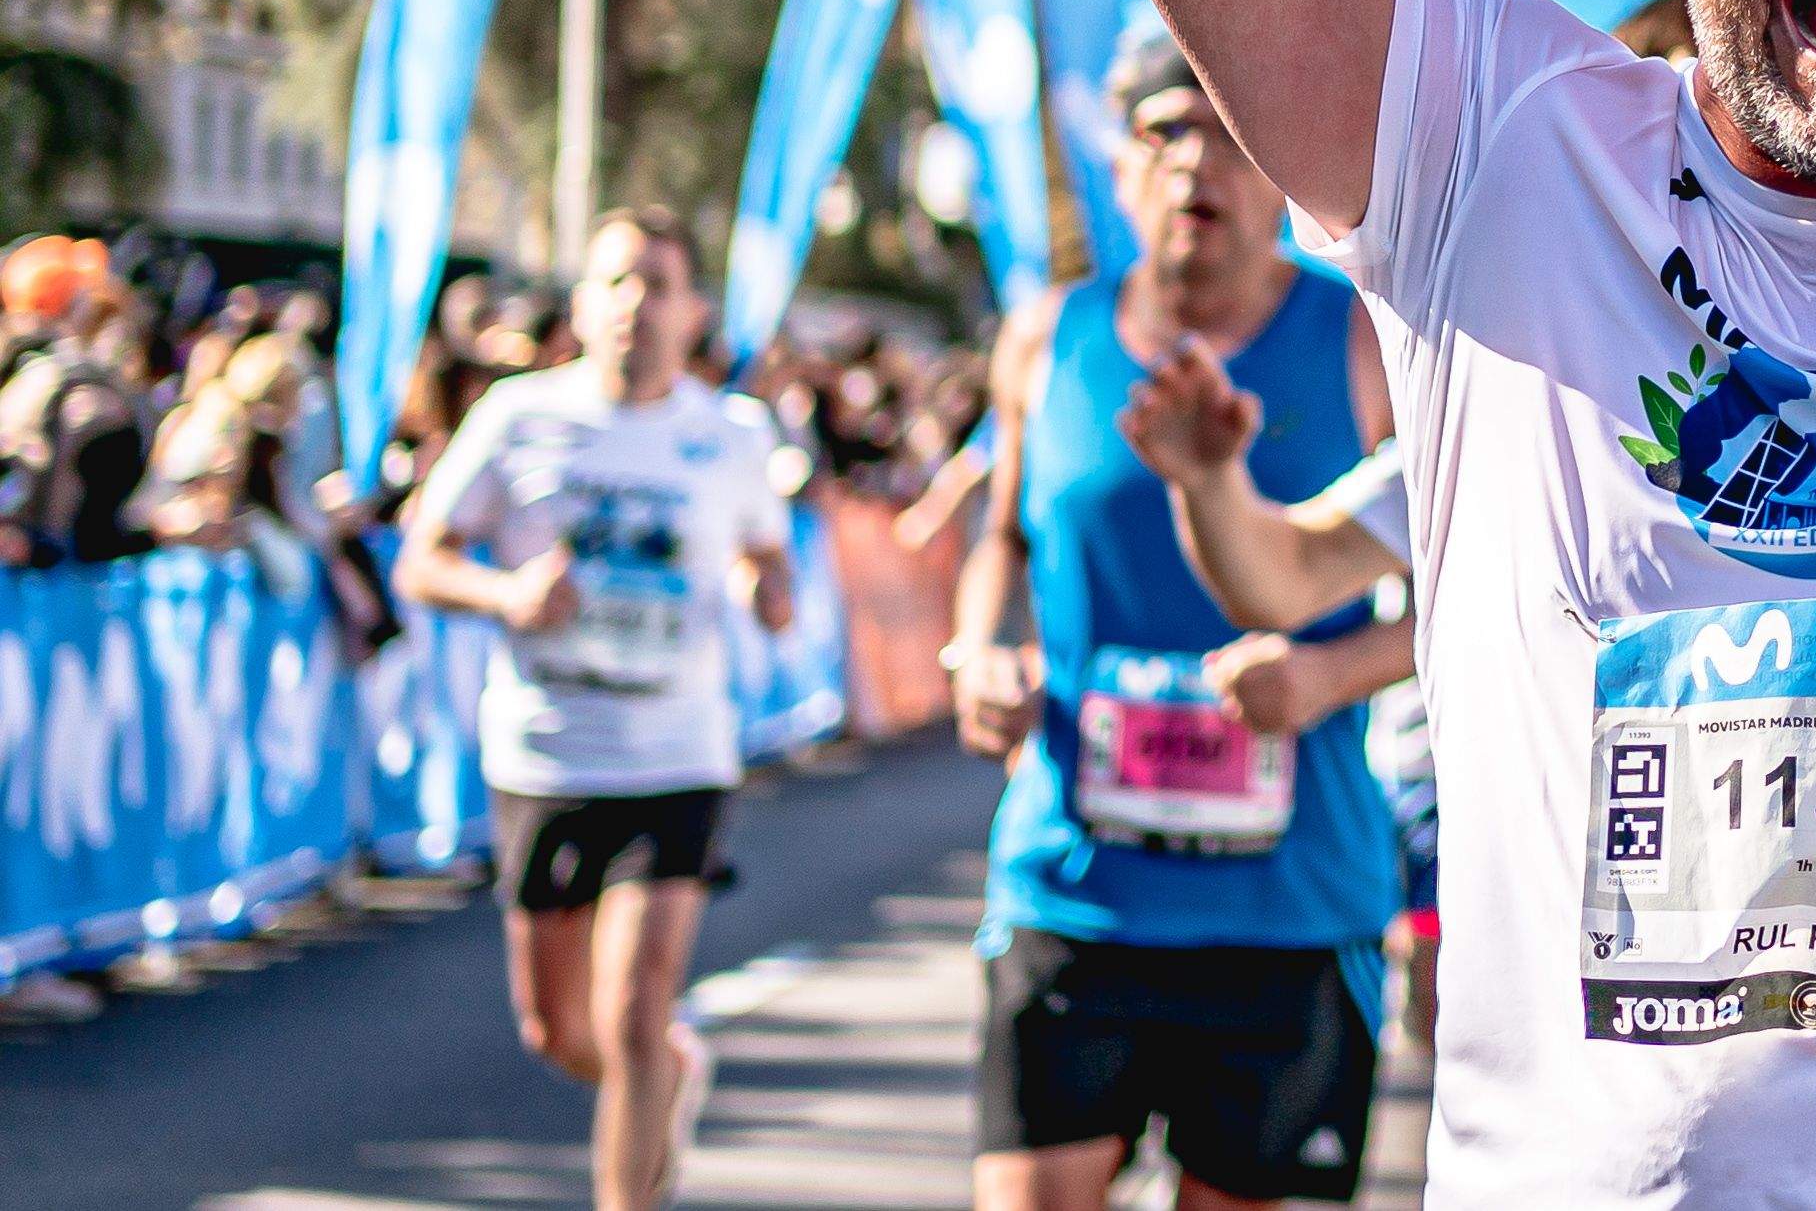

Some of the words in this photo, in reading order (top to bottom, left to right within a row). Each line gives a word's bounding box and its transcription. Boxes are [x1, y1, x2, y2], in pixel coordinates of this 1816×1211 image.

[1732, 528, 1784, 546] XXII
[1698, 718, 1766, 734] MOVISTAR
[1796, 859, 1813, 872] 1h
[1733, 923, 1796, 954] RUL
